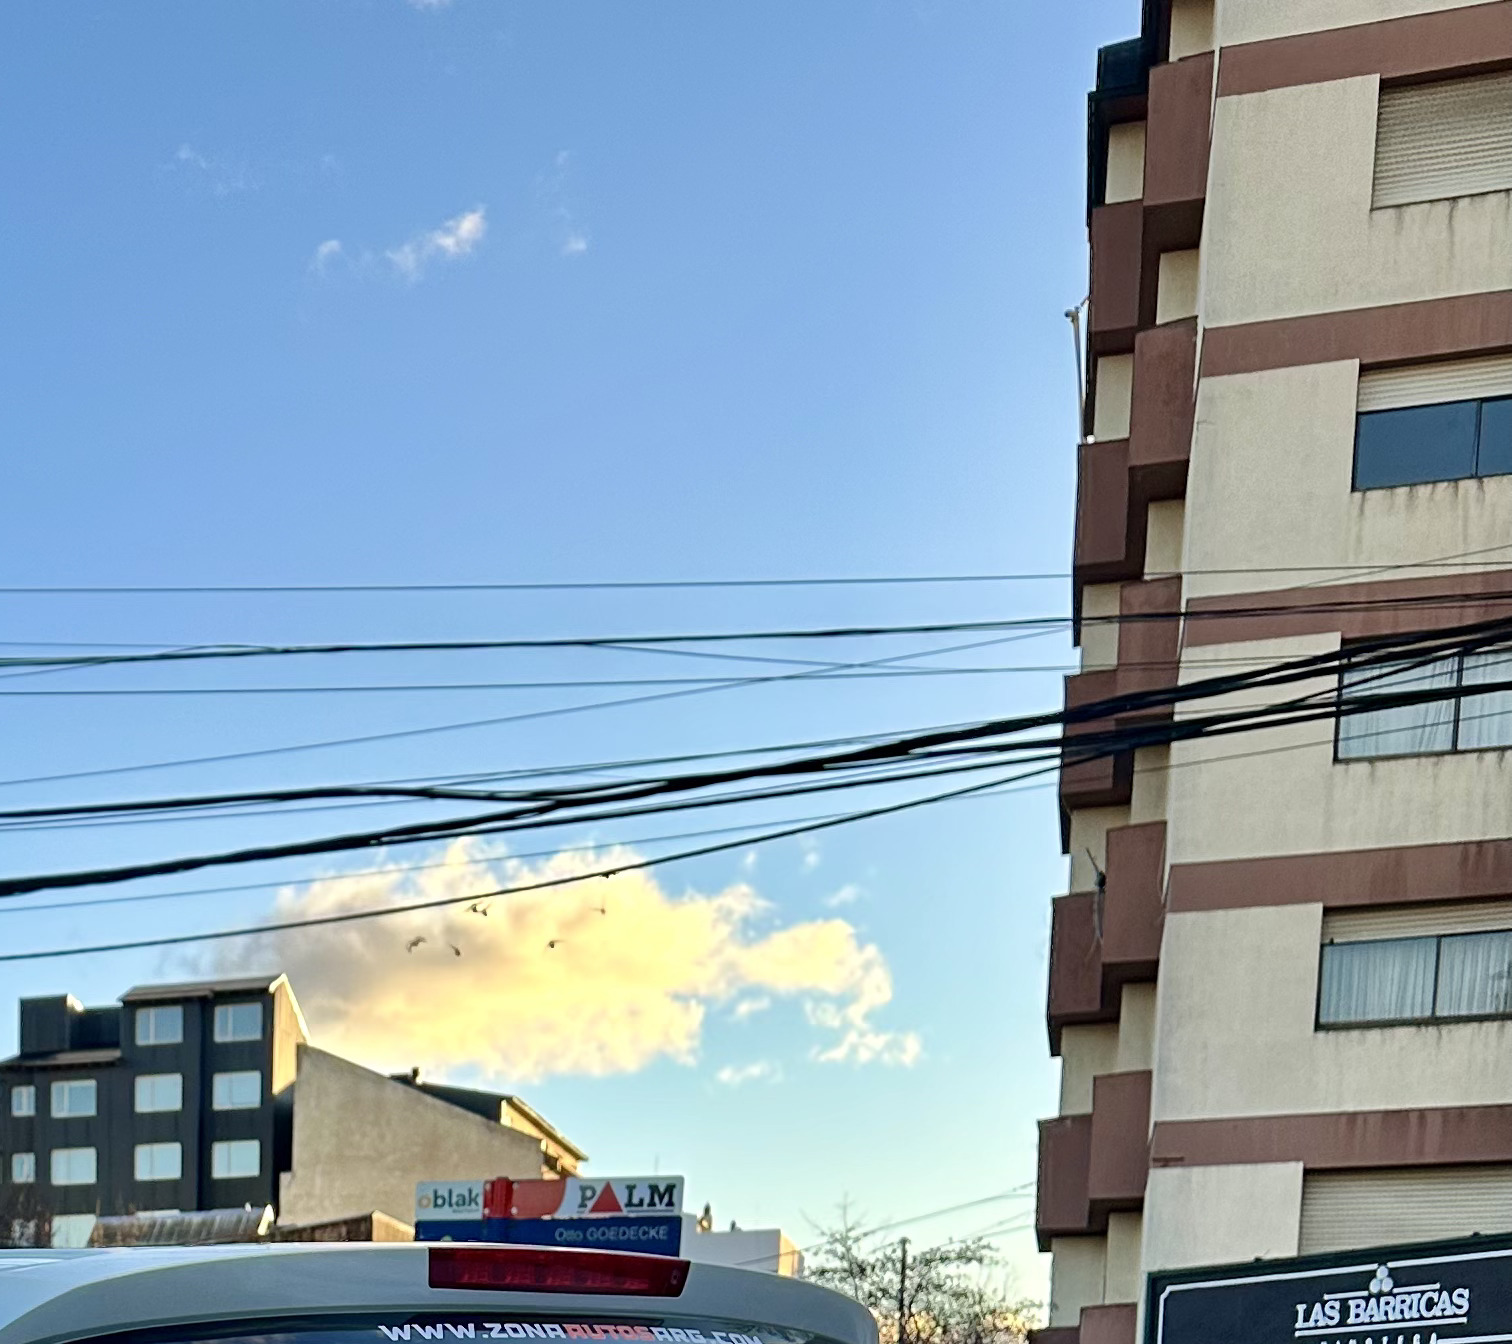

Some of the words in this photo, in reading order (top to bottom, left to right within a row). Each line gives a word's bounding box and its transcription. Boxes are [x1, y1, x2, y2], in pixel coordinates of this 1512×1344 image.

[587, 1225, 668, 1241] GOEDECKE
[1295, 1301, 1340, 1329] LAS
[1347, 1288, 1470, 1325] BARRICAS
